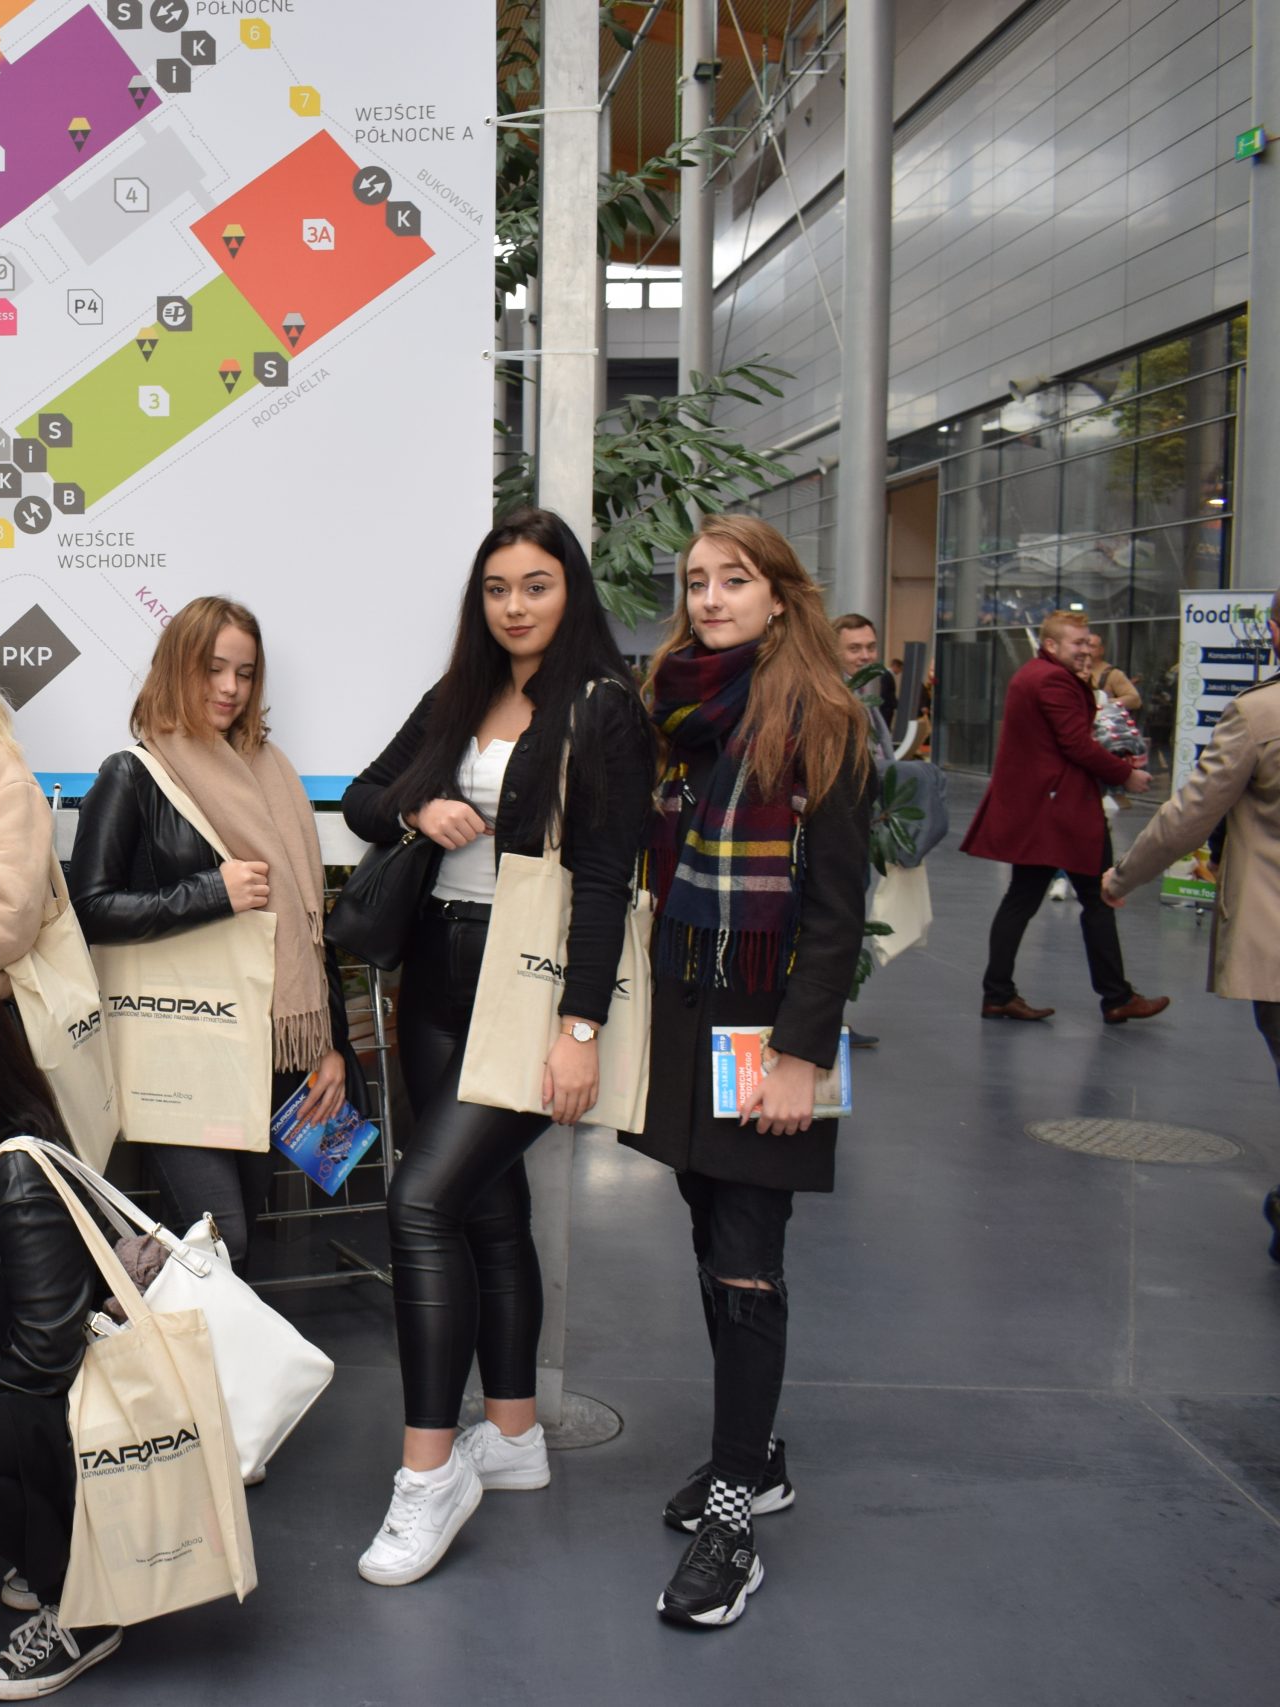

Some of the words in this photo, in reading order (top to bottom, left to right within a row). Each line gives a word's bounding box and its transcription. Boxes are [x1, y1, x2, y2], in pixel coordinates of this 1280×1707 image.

[118, 4, 130, 20] S
[250, 26, 260, 40] 6
[193, 40, 205, 56] K
[300, 93, 310, 108] 7
[356, 104, 435, 121] WEJŚCIE
[355, 127, 454, 143] PÓŁNOCNE
[462, 126, 474, 140] A
[126, 187, 138, 203] 4
[416, 168, 485, 226] BUKOWSKA
[397, 210, 410, 227] K
[307, 227, 332, 243] 3A
[75, 300, 98, 314] P4
[264, 361, 277, 378] S
[149, 393, 160, 409] 3
[252, 368, 330, 428] ROOSEVELTA
[49, 422, 62, 439] S
[0, 473, 12, 489] K
[64, 491, 75, 505] B
[58, 530, 135, 546] WEJŚCIE
[58, 554, 166, 568] WSCHODNIE
[3, 646, 52, 666] PKP
[109, 995, 237, 1017] TAROPAK
